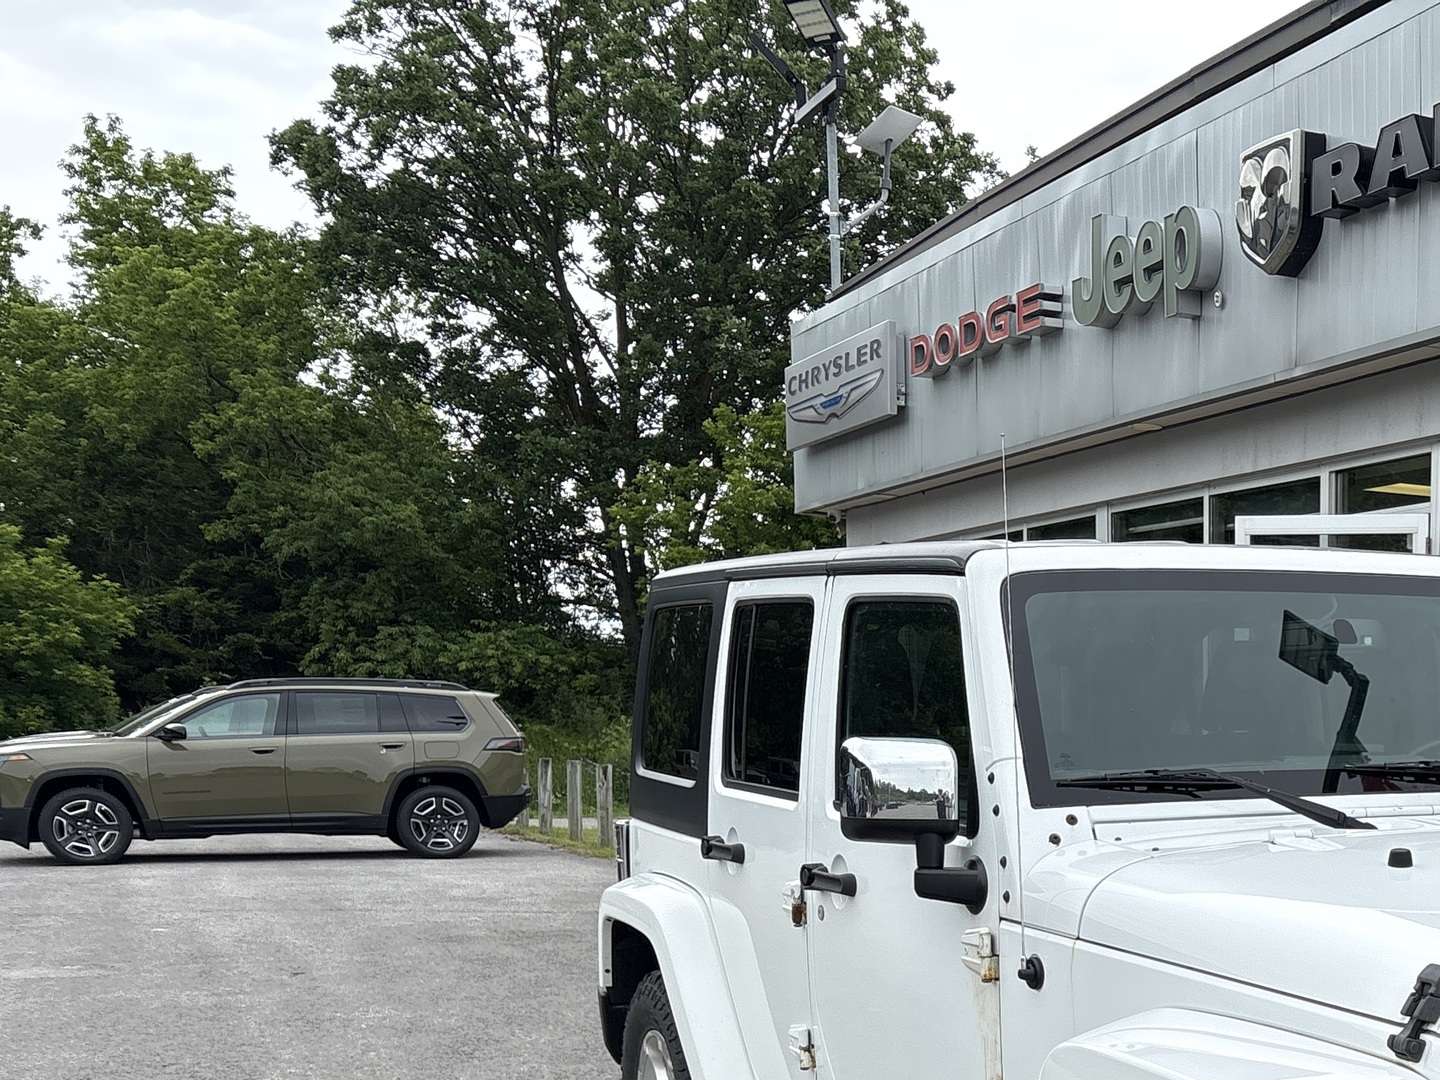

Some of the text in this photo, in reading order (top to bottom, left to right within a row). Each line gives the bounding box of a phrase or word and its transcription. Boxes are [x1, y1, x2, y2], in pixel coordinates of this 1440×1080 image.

[1072, 205, 1223, 329] Jeep
[787, 338, 883, 396] CHRYSLER
[909, 282, 1063, 378] DODGE
